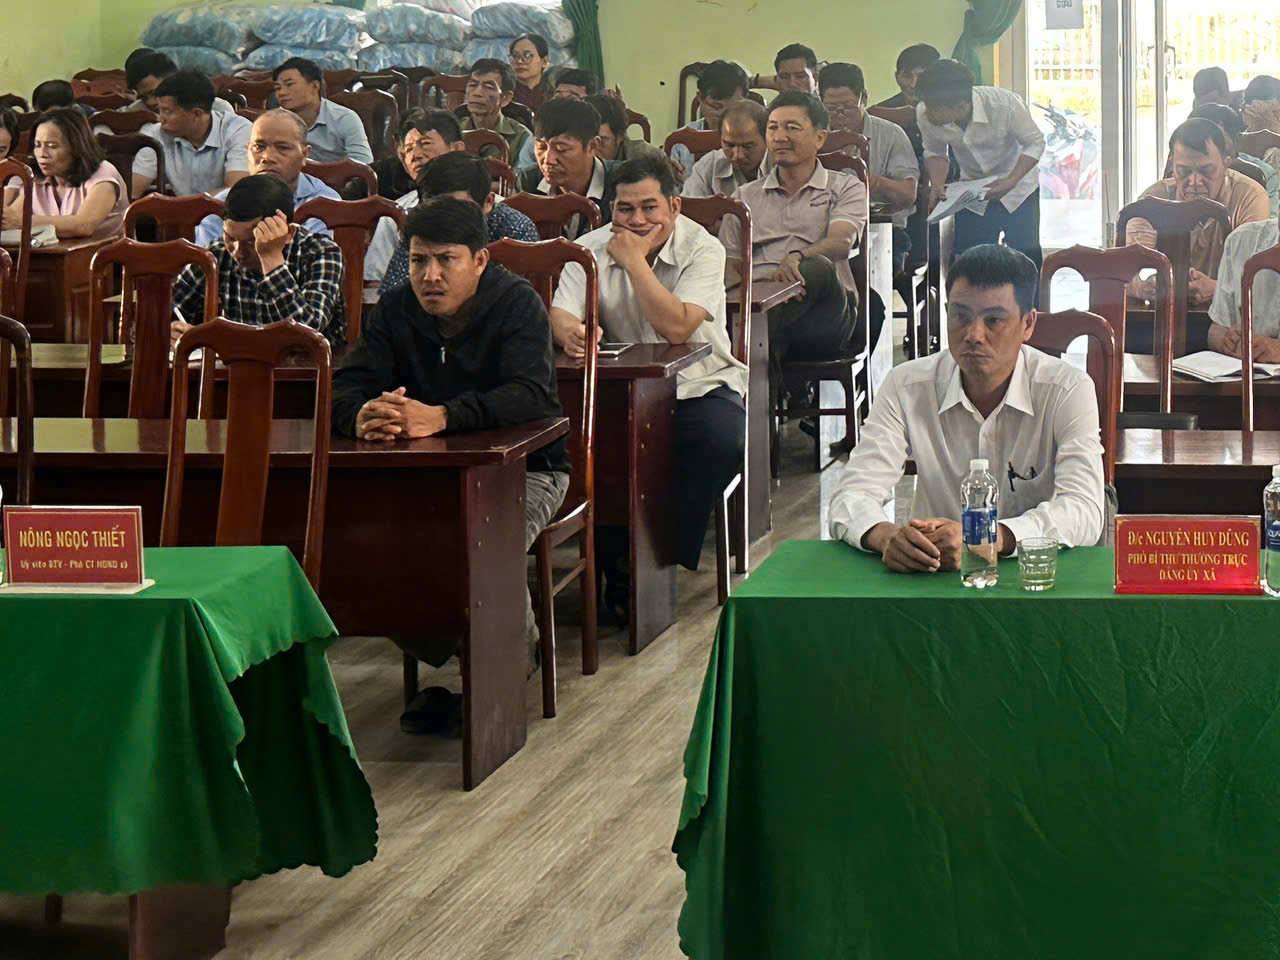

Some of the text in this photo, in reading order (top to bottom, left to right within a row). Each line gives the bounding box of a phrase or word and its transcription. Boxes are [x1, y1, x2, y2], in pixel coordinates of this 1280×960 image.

[19, 524, 126, 550] NÔNG NGỌC THIẾT
[1193, 531, 1217, 546] HUY
[1222, 552, 1248, 568] TRỰC
